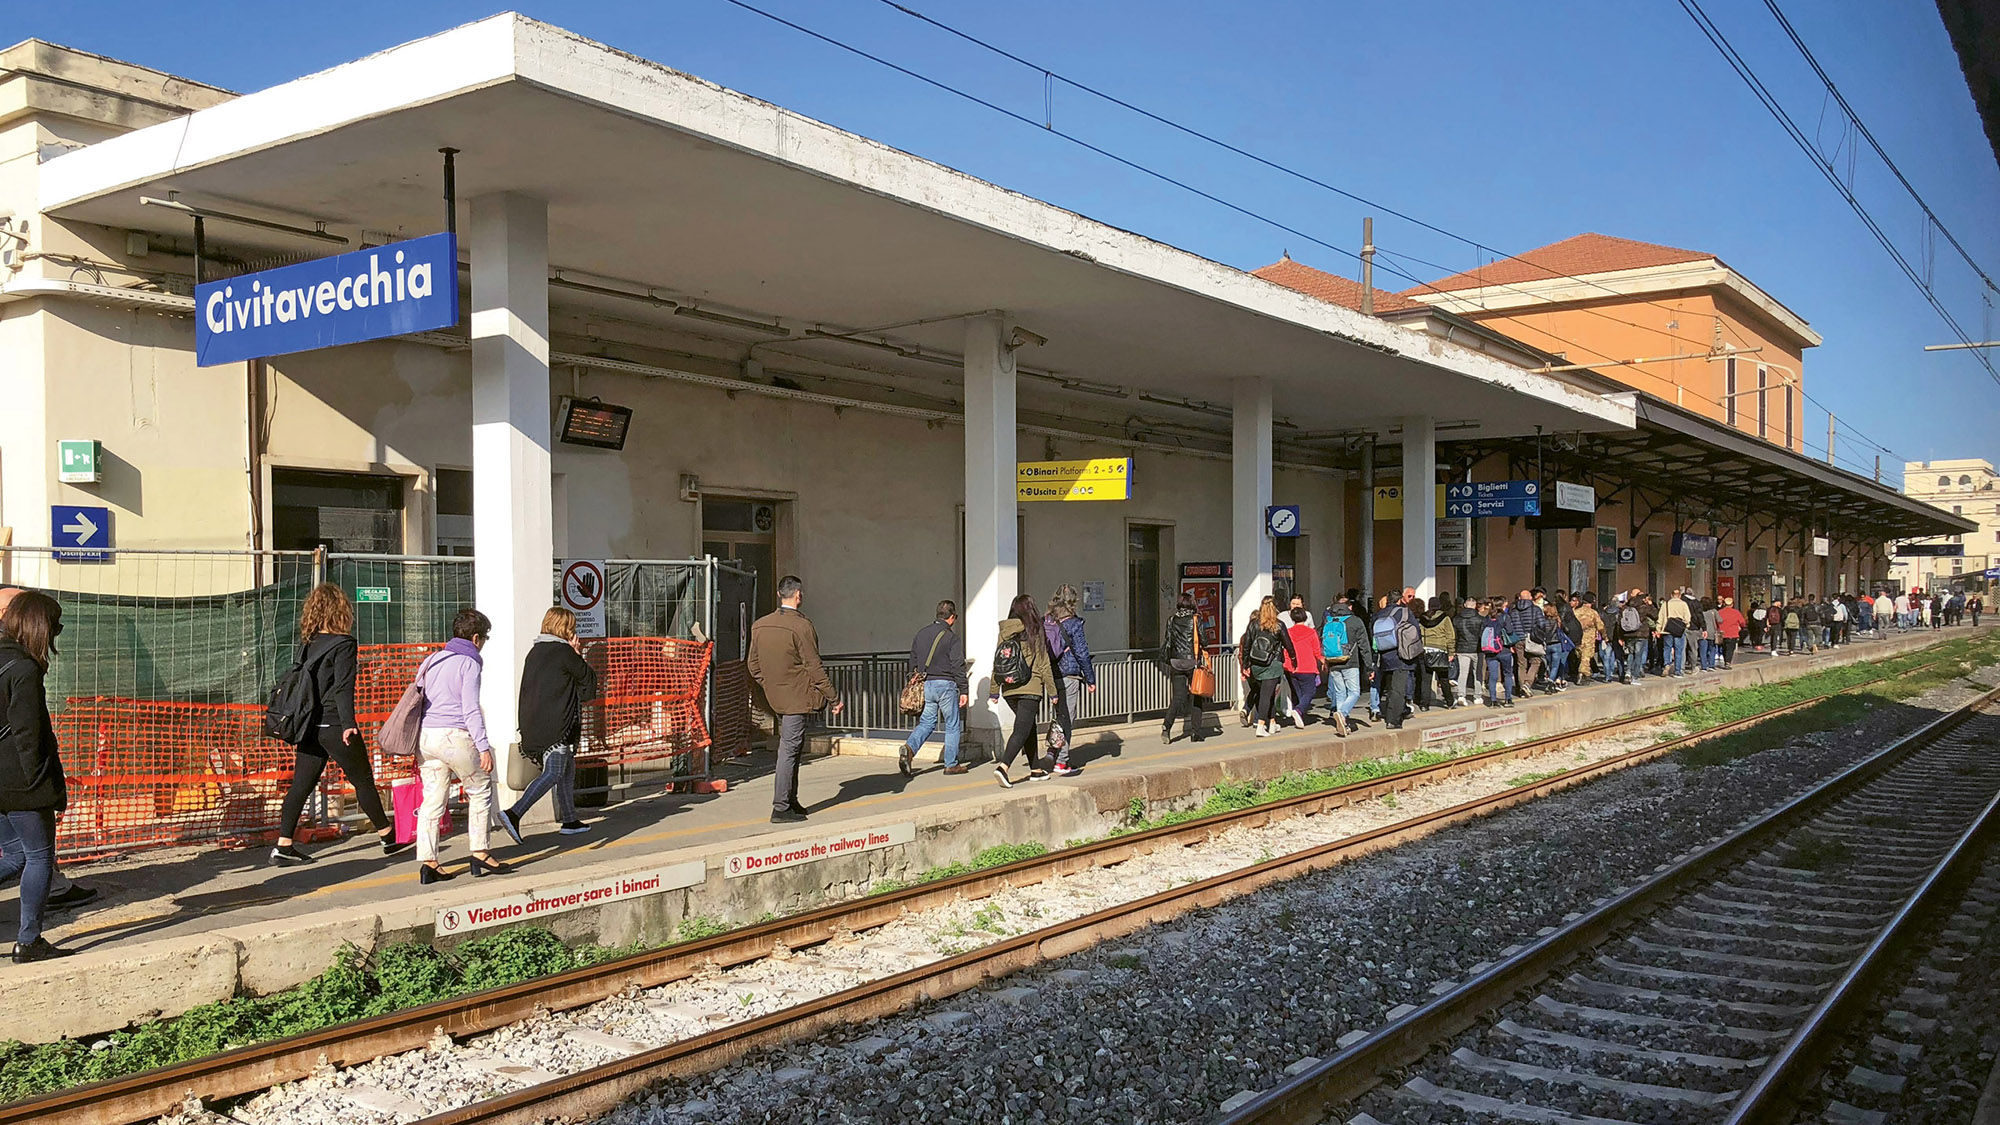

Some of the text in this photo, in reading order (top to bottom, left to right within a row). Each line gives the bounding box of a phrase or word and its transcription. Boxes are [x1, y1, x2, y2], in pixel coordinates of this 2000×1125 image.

[206, 250, 432, 334] Civitavecchia
[1034, 467, 1058, 476] Binari
[1060, 466, 1091, 475] Platforms
[1094, 466, 1099, 474] 2
[1033, 488, 1070, 496] Uscita Exit
[1477, 482, 1508, 493] Biglietti
[1477, 500, 1504, 508] Servizi
[746, 832, 890, 869] Do not cross the railway lines
[467, 874, 660, 925] Vietato attraversare i binari
